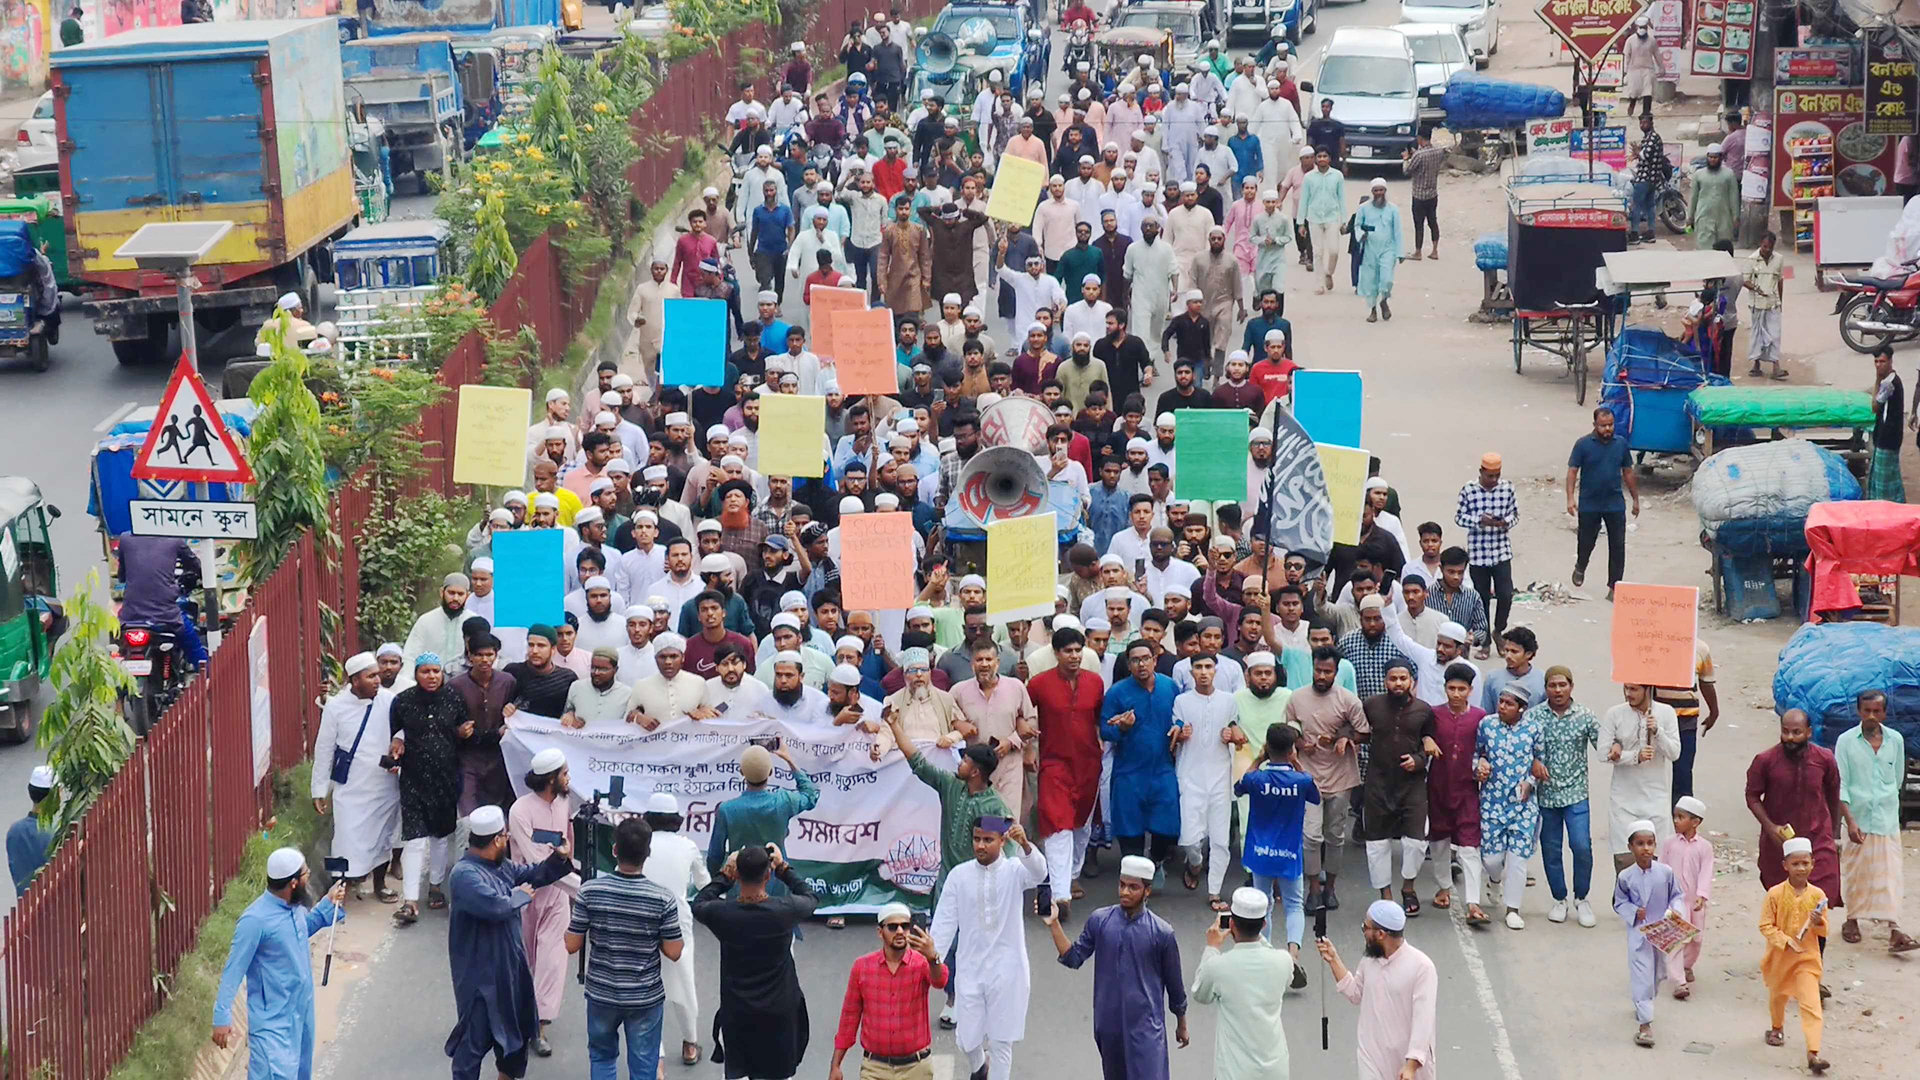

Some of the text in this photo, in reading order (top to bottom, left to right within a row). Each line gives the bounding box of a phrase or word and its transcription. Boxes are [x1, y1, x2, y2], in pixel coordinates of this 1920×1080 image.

[1798, 93, 1841, 112] বনফুল
[141, 507, 248, 534] সামনে স্কুল
[588, 756, 643, 774] ইসকনের
[647, 762, 681, 775] সকল
[652, 782, 680, 793] এবং
[684, 778, 725, 794] ইসকন
[1260, 783, 1298, 796] Joni
